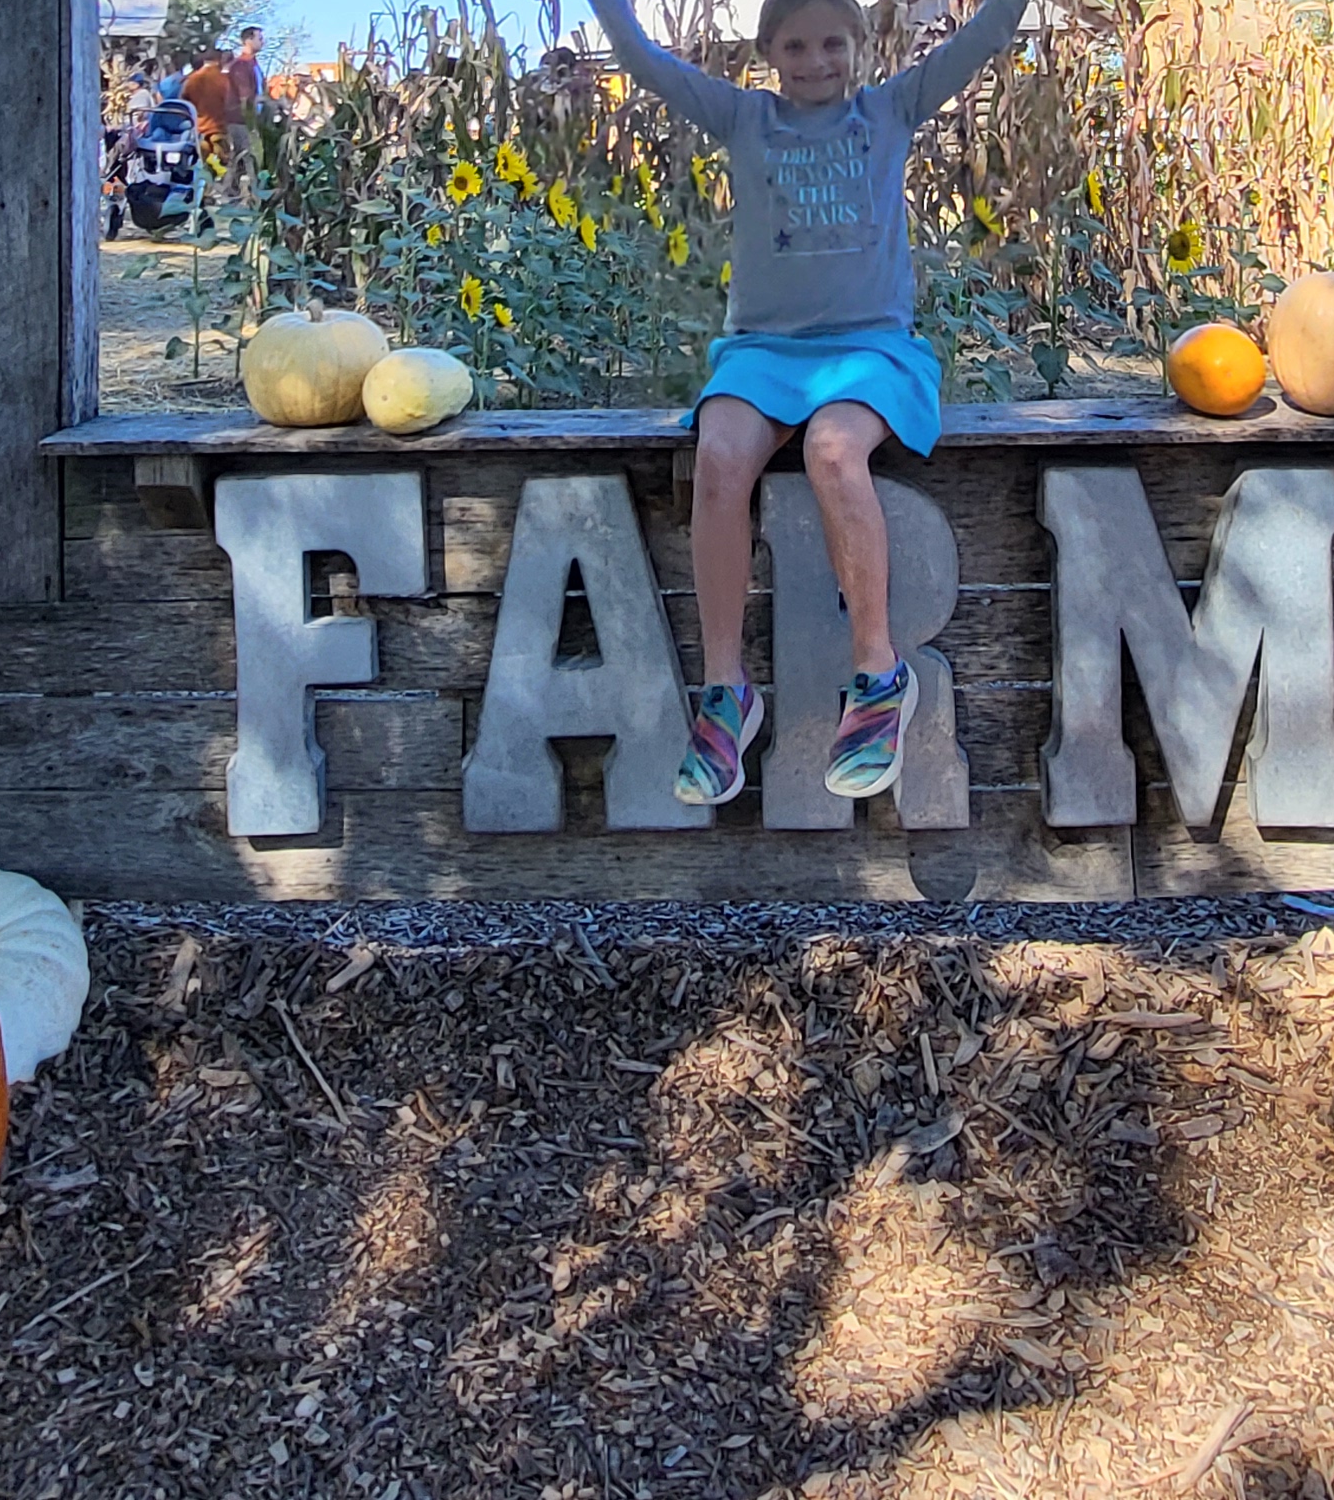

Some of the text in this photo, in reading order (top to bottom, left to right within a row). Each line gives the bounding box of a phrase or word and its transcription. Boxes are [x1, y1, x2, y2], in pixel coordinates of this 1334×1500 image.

[781, 137, 854, 164] DREAM
[777, 158, 864, 185] BEYOND
[798, 184, 843, 205] THE
[787, 202, 858, 228] STARS
